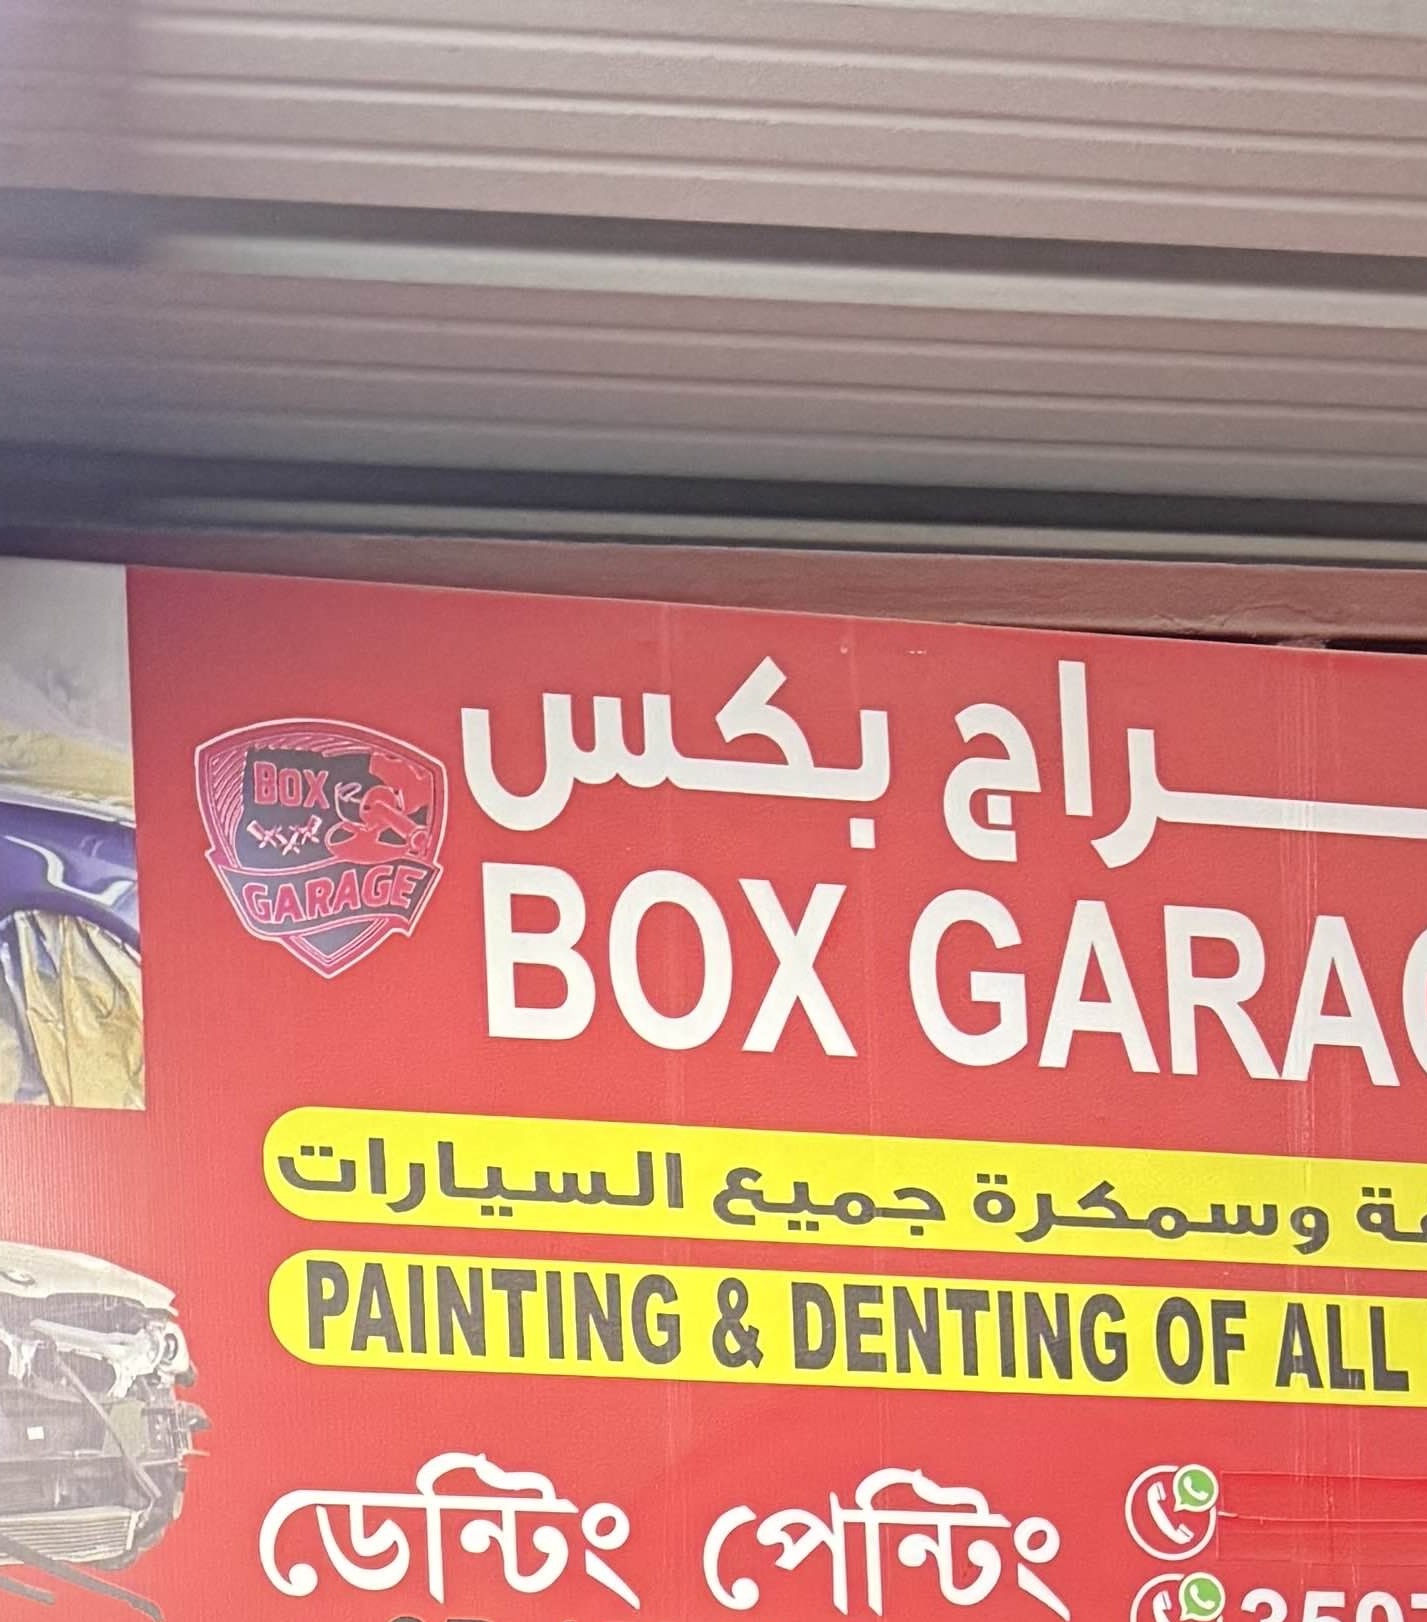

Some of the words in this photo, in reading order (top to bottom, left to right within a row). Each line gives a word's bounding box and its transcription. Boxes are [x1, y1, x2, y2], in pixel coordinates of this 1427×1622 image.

[253, 761, 330, 809] BOX
[461, 656, 890, 848] بكس
[241, 865, 428, 925] GARAGE
[482, 862, 857, 1056] BOX
[278, 1137, 683, 1216] السيارات
[714, 1167, 945, 1235] جميع
[974, 1174, 1329, 1254] وسمكرة
[307, 1260, 680, 1364] PAINTING
[713, 1278, 763, 1370] &
[792, 1281, 1127, 1381] DENTING
[1156, 1297, 1246, 1385] OF
[1276, 1303, 1409, 1391] ALL
[259, 1453, 640, 1609] ডেন্টিং
[703, 1467, 1070, 1621] পেন্টিং
